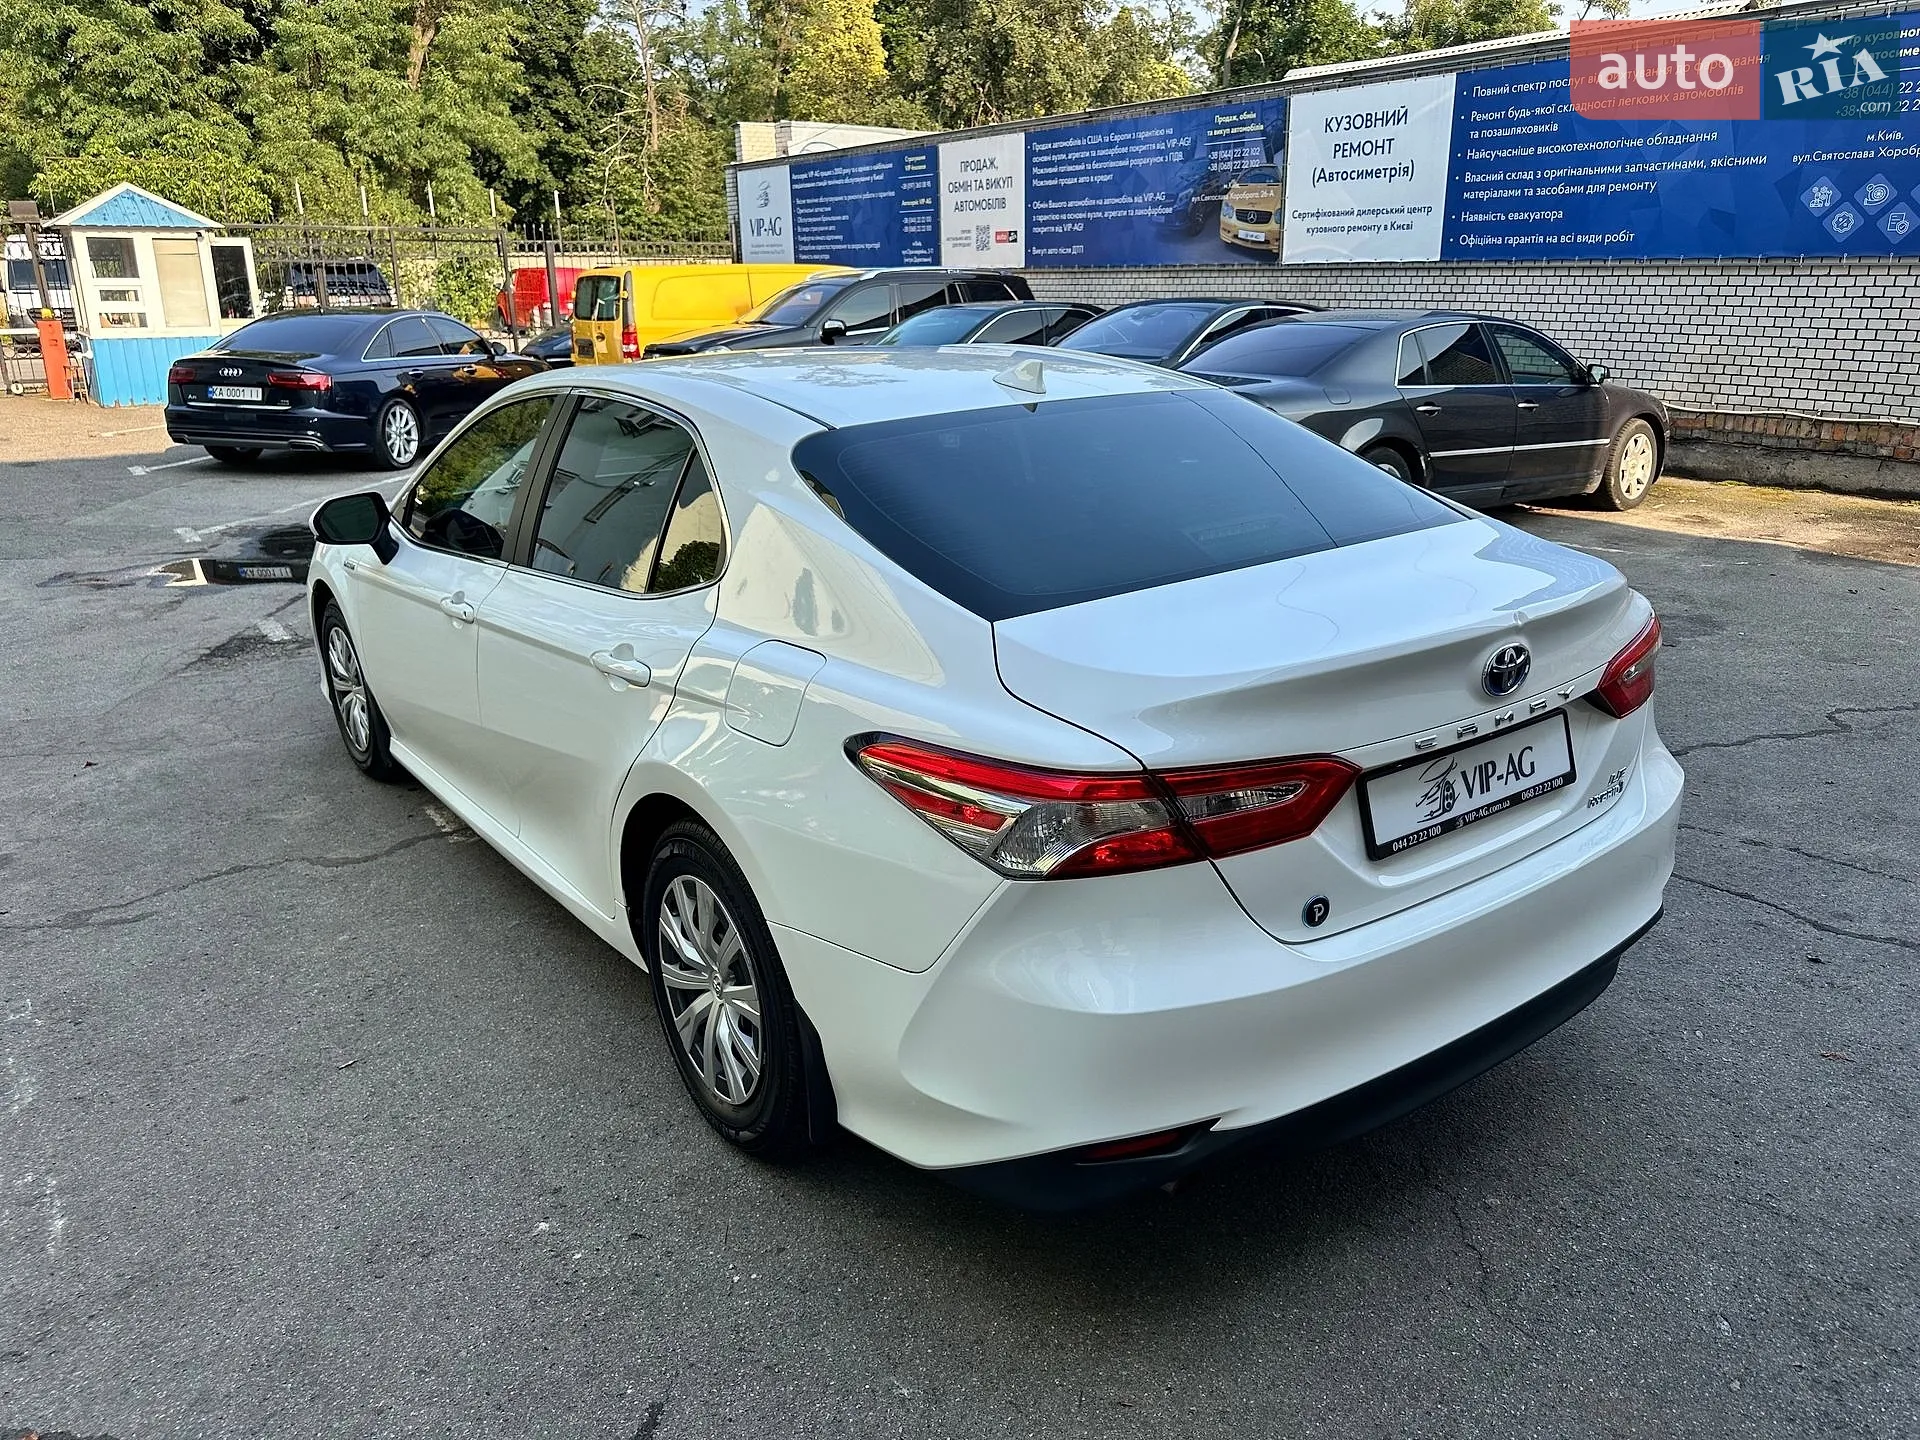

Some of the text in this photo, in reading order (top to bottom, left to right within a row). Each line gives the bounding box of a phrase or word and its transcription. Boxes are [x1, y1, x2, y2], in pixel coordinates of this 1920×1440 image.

[1472, 84, 1510, 98] Повний
[1512, 80, 1546, 94] спектр
[1549, 76, 1584, 90] послуг
[1839, 82, 1913, 100] +38 (044) 22
[1471, 83, 1744, 123] Ремонт будь-якої складності легкових автомобілів
[1893, 100, 1910, 113] 22
[1324, 105, 1409, 133] КУЗОВНИЙ
[1470, 120, 1559, 140] та позашляховиків
[1866, 129, 1904, 142] м.Київ,
[1333, 138, 1395, 160] РЕМОНТ
[1467, 131, 1718, 162] Найсучасніше високотехнологічне обладнання
[960, 158, 998, 173] ПРОДАЖ,
[1792, 150, 1875, 164] вул.Святослава
[1312, 160, 1415, 188] (Автосиметрія)
[1465, 153, 1767, 184] Власний склад з оригінальними запчастинами, якісними
[948, 179, 972, 193] ОБМІН
[974, 179, 984, 191] ТА
[985, 176, 1013, 190] ВИКУП
[1463, 180, 1657, 201] матеріалами та засобами для ремонту
[953, 197, 1007, 212] АВТОМОБІЛІВ
[1292, 205, 1433, 221] Сертифікований дилерський центр
[1461, 208, 1563, 223] Наявність евакуатора
[1306, 223, 1345, 235] кузовного
[1347, 222, 1381, 235] ремонту
[1459, 230, 1635, 247] Офіційна гарантія на всі види робіт
[226, 388, 246, 398] 0001
[1415, 685, 1575, 750] CAMRY
[1460, 746, 1535, 799] VIP-AG
[1521, 777, 1563, 800] 068 22 22 100
[1465, 800, 1510, 823] VIP-AG.com.ua
[1393, 825, 1441, 852] 044 22 22 100
